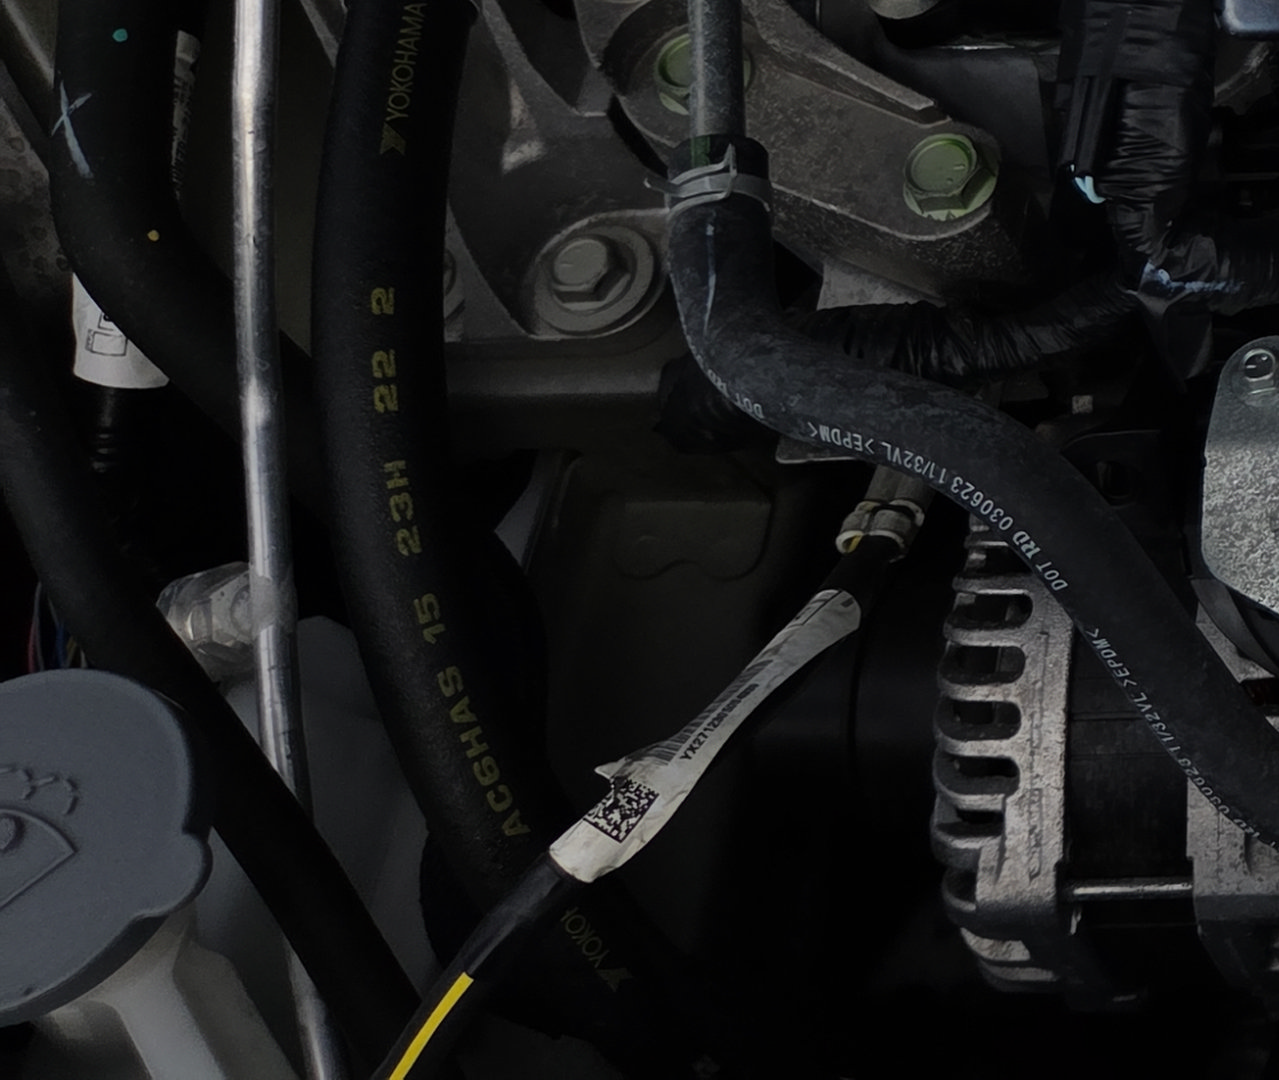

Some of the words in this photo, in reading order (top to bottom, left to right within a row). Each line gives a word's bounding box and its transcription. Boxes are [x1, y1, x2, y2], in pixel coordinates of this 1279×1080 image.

[385, 2, 428, 122] YOKOHAMA
[370, 287, 395, 316] 2
[371, 349, 399, 413] 22
[807, 422, 875, 455] >EPDM<
[384, 460, 422, 556] 23H
[951, 476, 1014, 530] 030623
[1035, 561, 1069, 591] DOT
[413, 593, 446, 644] 15
[1086, 627, 1138, 688] >EPDM<
